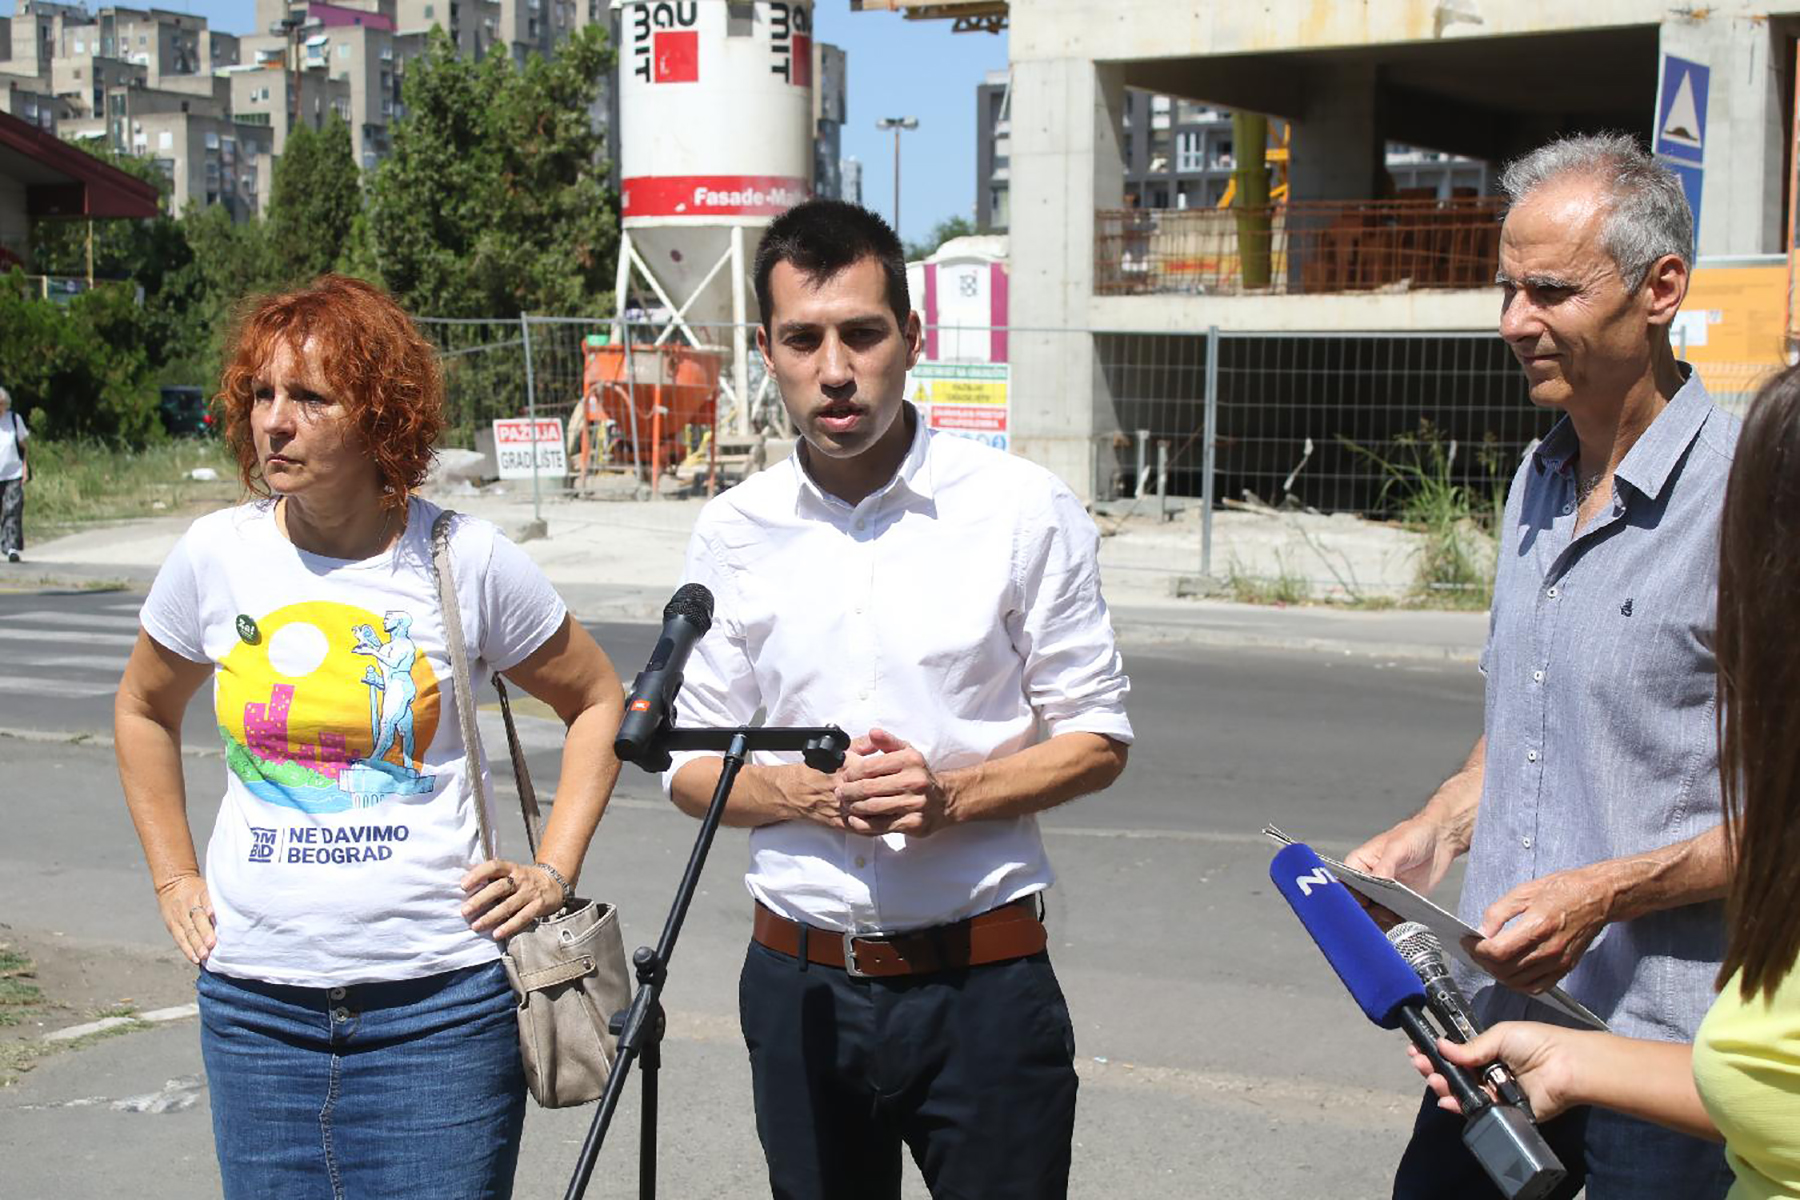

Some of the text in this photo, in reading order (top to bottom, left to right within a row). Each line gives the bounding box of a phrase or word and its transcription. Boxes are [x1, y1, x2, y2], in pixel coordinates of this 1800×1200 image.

[289, 825, 409, 844] NE DAVIMO
[287, 845, 393, 865] BEOGRAD
